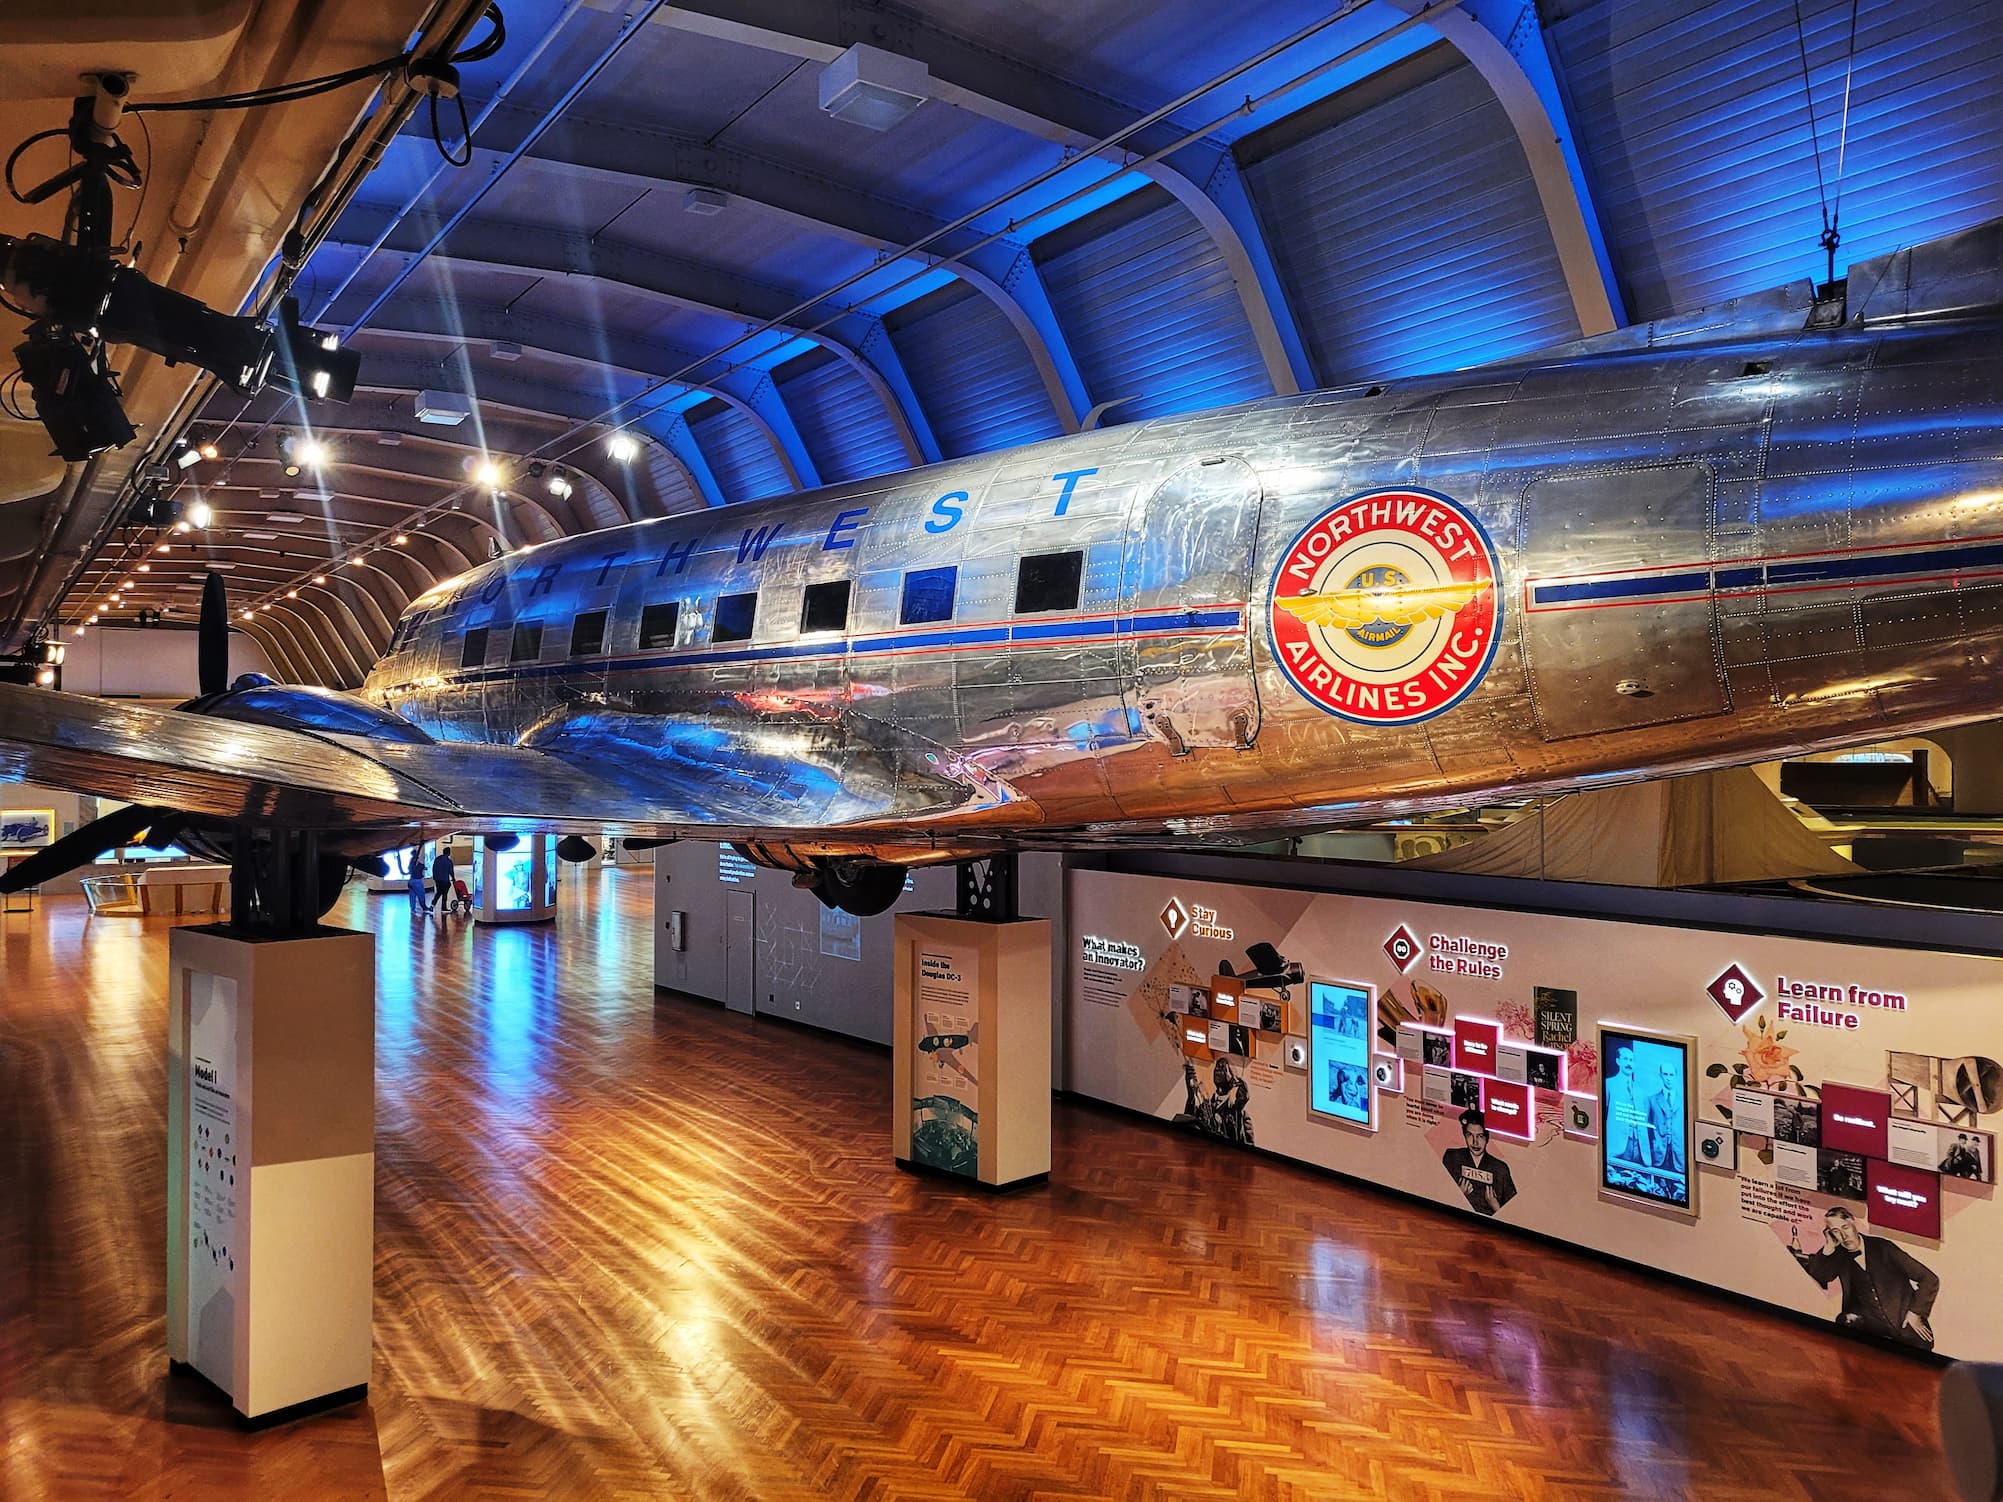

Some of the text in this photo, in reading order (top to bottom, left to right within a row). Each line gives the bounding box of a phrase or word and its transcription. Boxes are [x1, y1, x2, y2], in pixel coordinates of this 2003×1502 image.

[1289, 500, 1476, 580] NORTHWEST
[1357, 626, 1401, 642] AIRMAIL
[1285, 627, 1483, 711] AIRLINES INC.
[1191, 906, 1216, 922] Stay
[1191, 923, 1233, 940] Curious
[1082, 937, 1139, 957] What makes
[1429, 935, 1508, 961] Challenge
[921, 959, 950, 970] Inside the
[1082, 952, 1094, 962] an
[921, 969, 962, 982] Douglas DC-3
[1429, 955, 1502, 979] the Rules
[1777, 976, 1906, 1010] Learn from
[1541, 1010, 1573, 1023] SILENT
[1777, 1001, 1859, 1029] Failure
[1541, 1020, 1573, 1033] SPRING
[1542, 1030, 1572, 1043] Rachel
[195, 1063, 214, 1084] Model
[1752, 1178, 1769, 1188] learn
[1785, 1187, 1801, 1195] from
[1753, 1185, 1777, 1197] failures
[1741, 1191, 1752, 1199] put
[1753, 1193, 1766, 1201] into
[1779, 1200, 1797, 1209] effort
[1798, 1204, 1810, 1212] the
[1741, 1198, 1755, 1207] best
[1756, 1201, 1782, 1213] thought
[1783, 1208, 1796, 1216] and
[1763, 1210, 1790, 1222] capable
